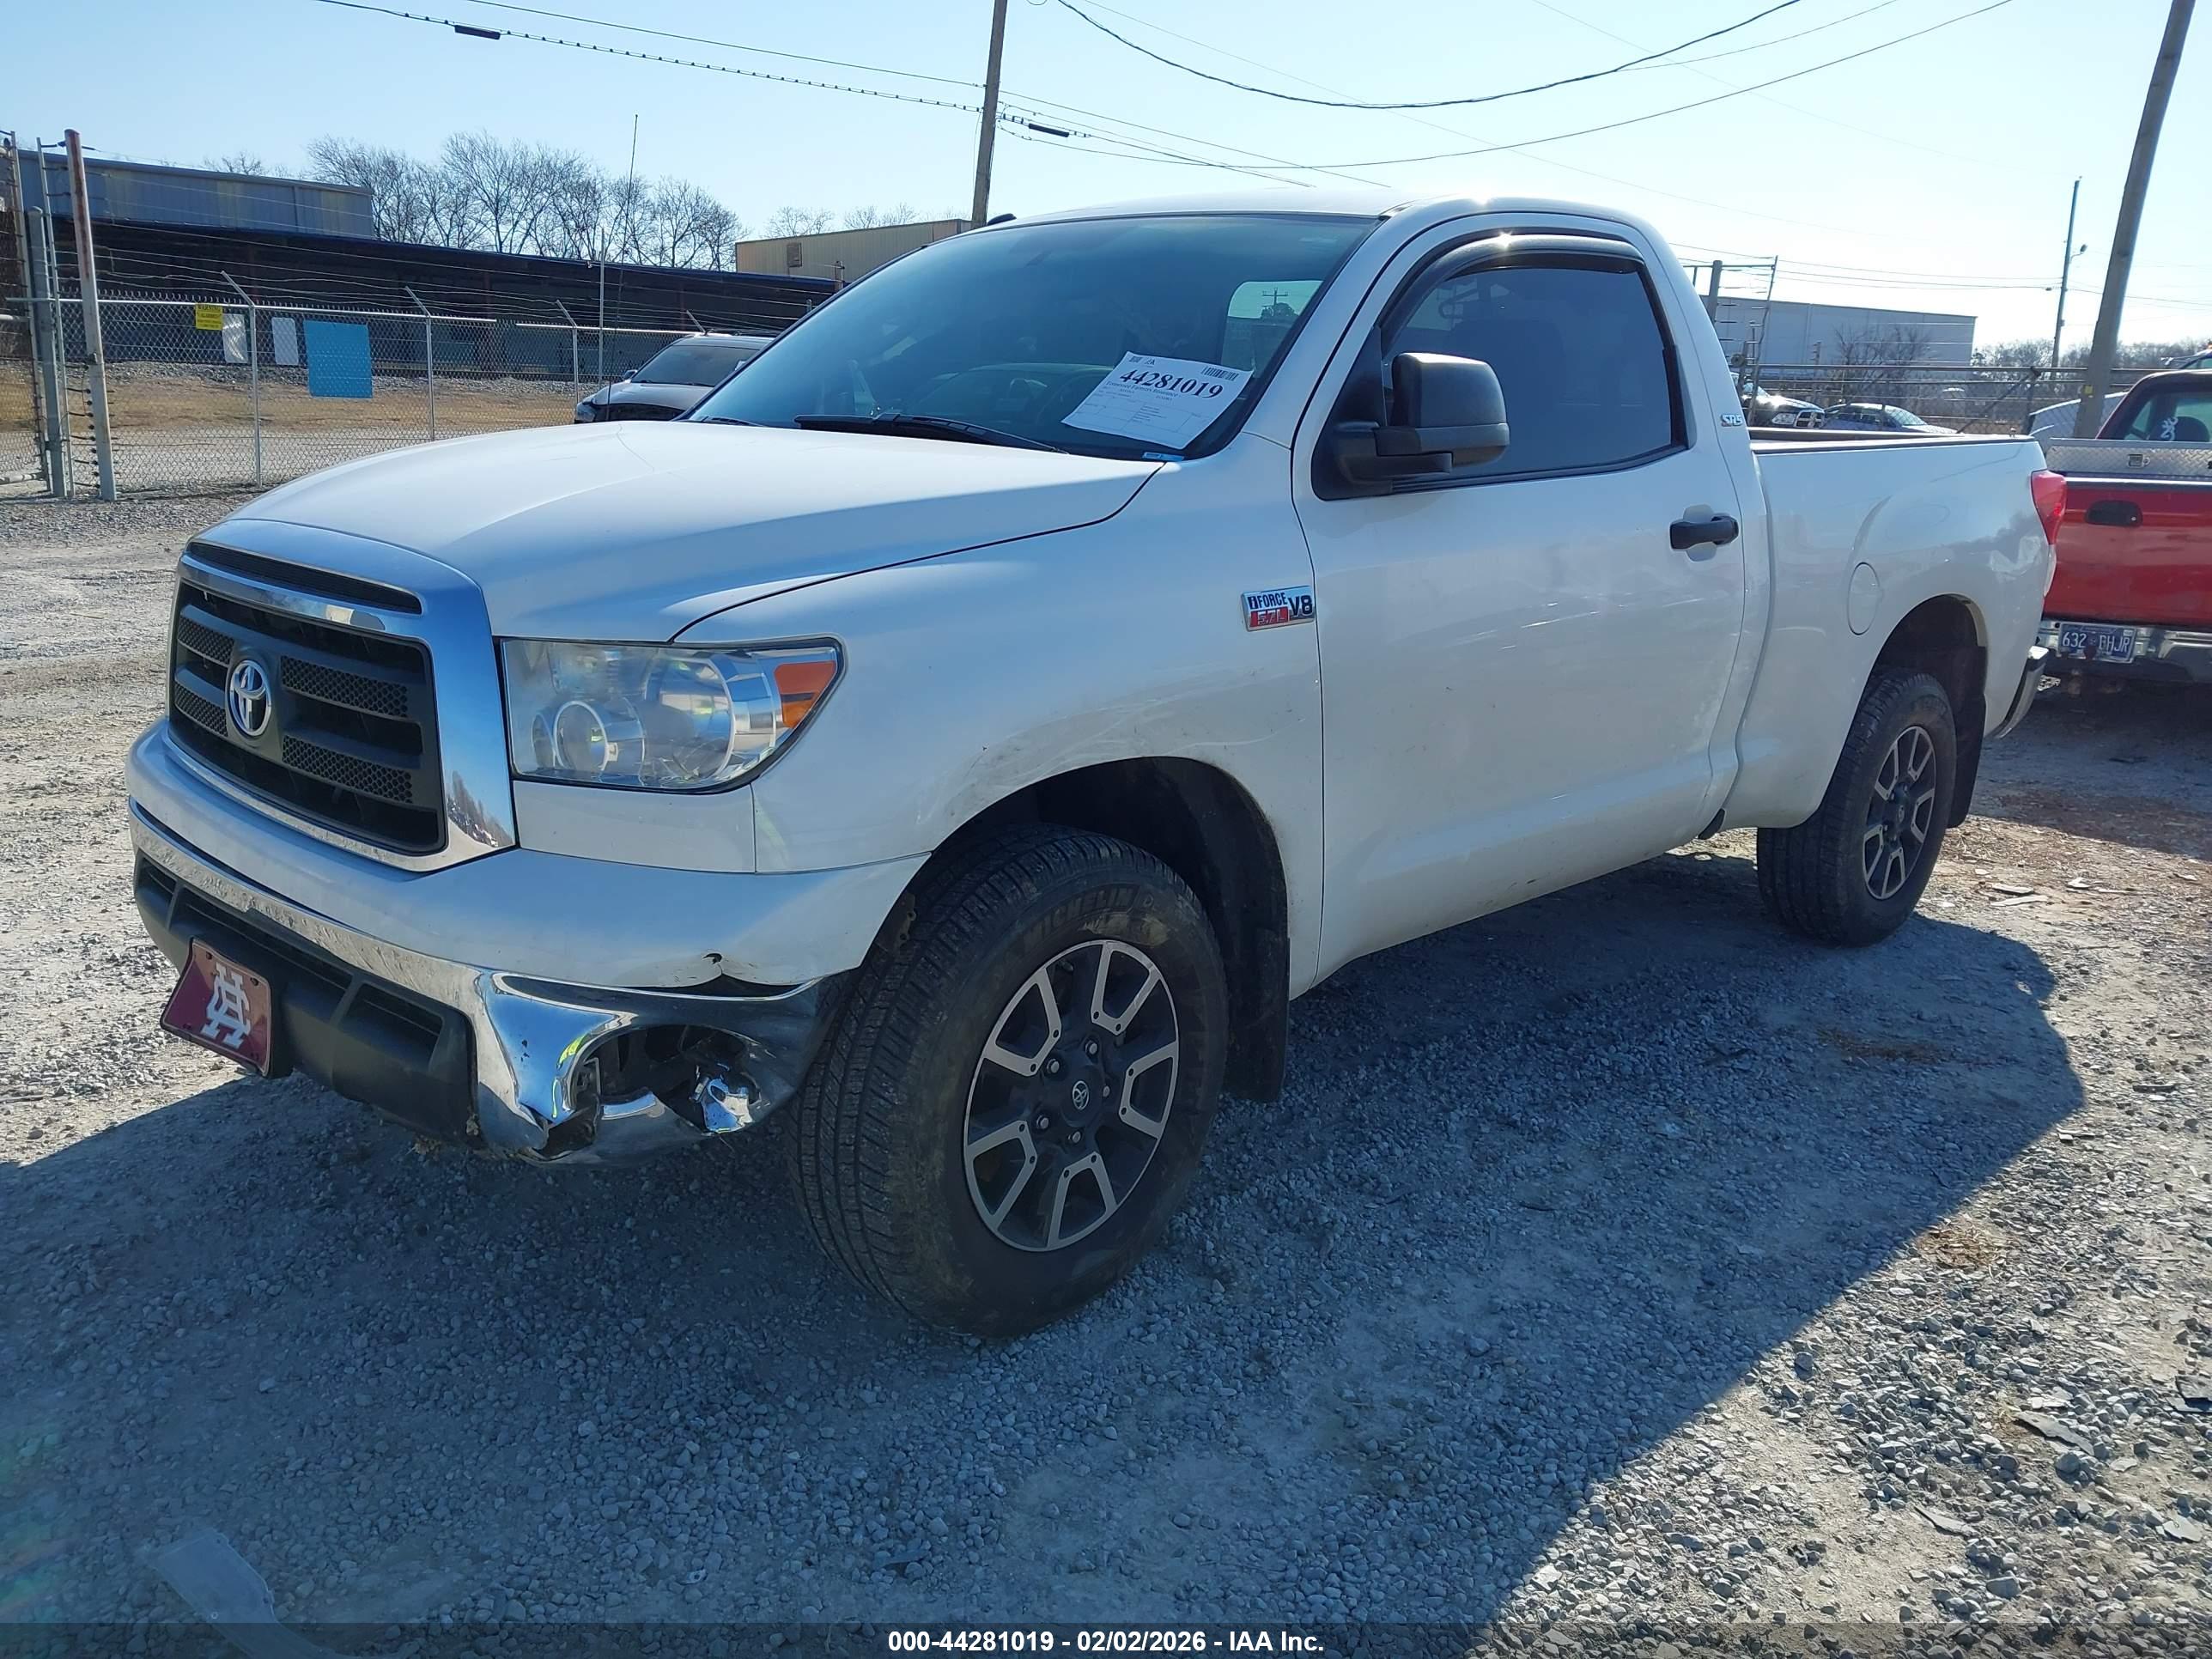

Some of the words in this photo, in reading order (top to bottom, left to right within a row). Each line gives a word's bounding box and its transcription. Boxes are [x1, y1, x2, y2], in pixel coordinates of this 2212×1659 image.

[1120, 369, 1224, 398] 44281019
[1288, 595, 1313, 617] V8
[2063, 631, 2087, 648] 632
[1023, 887, 1136, 950] MICHELIN
